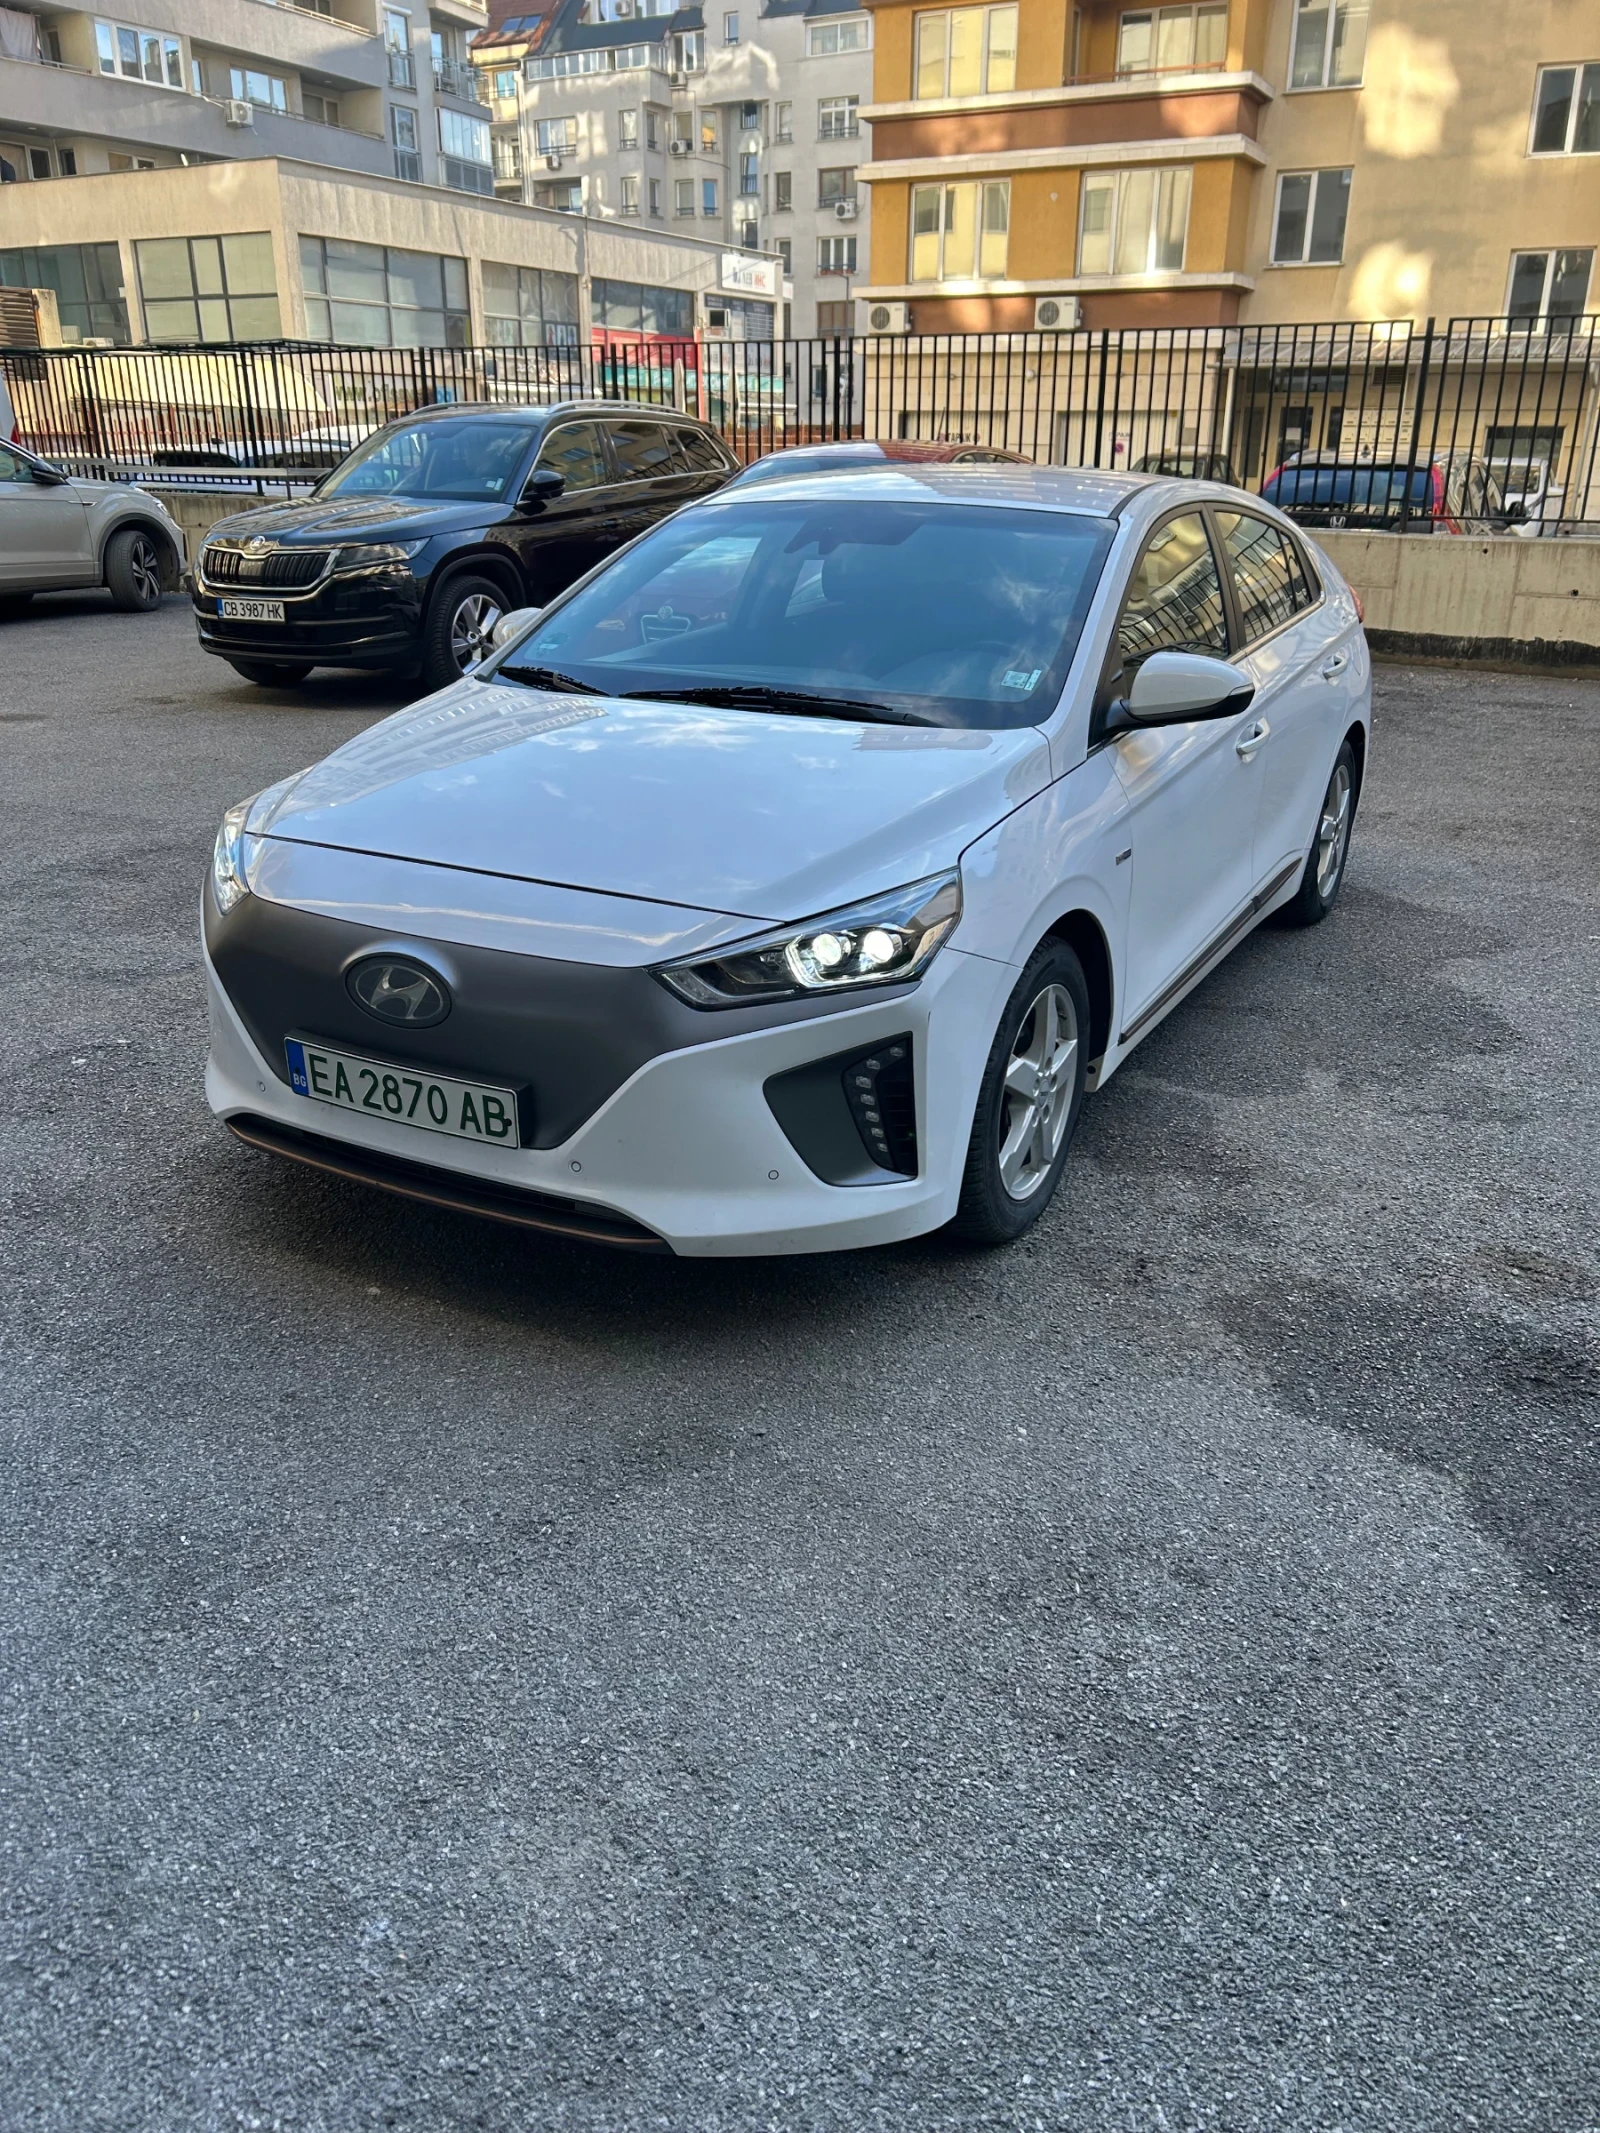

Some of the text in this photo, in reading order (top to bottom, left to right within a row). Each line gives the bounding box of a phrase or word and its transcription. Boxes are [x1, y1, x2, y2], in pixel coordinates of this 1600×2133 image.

[224, 601, 282, 619] CB 3987 HK
[293, 1073, 306, 1087] BG
[308, 1053, 509, 1138] EA 2870 AB
